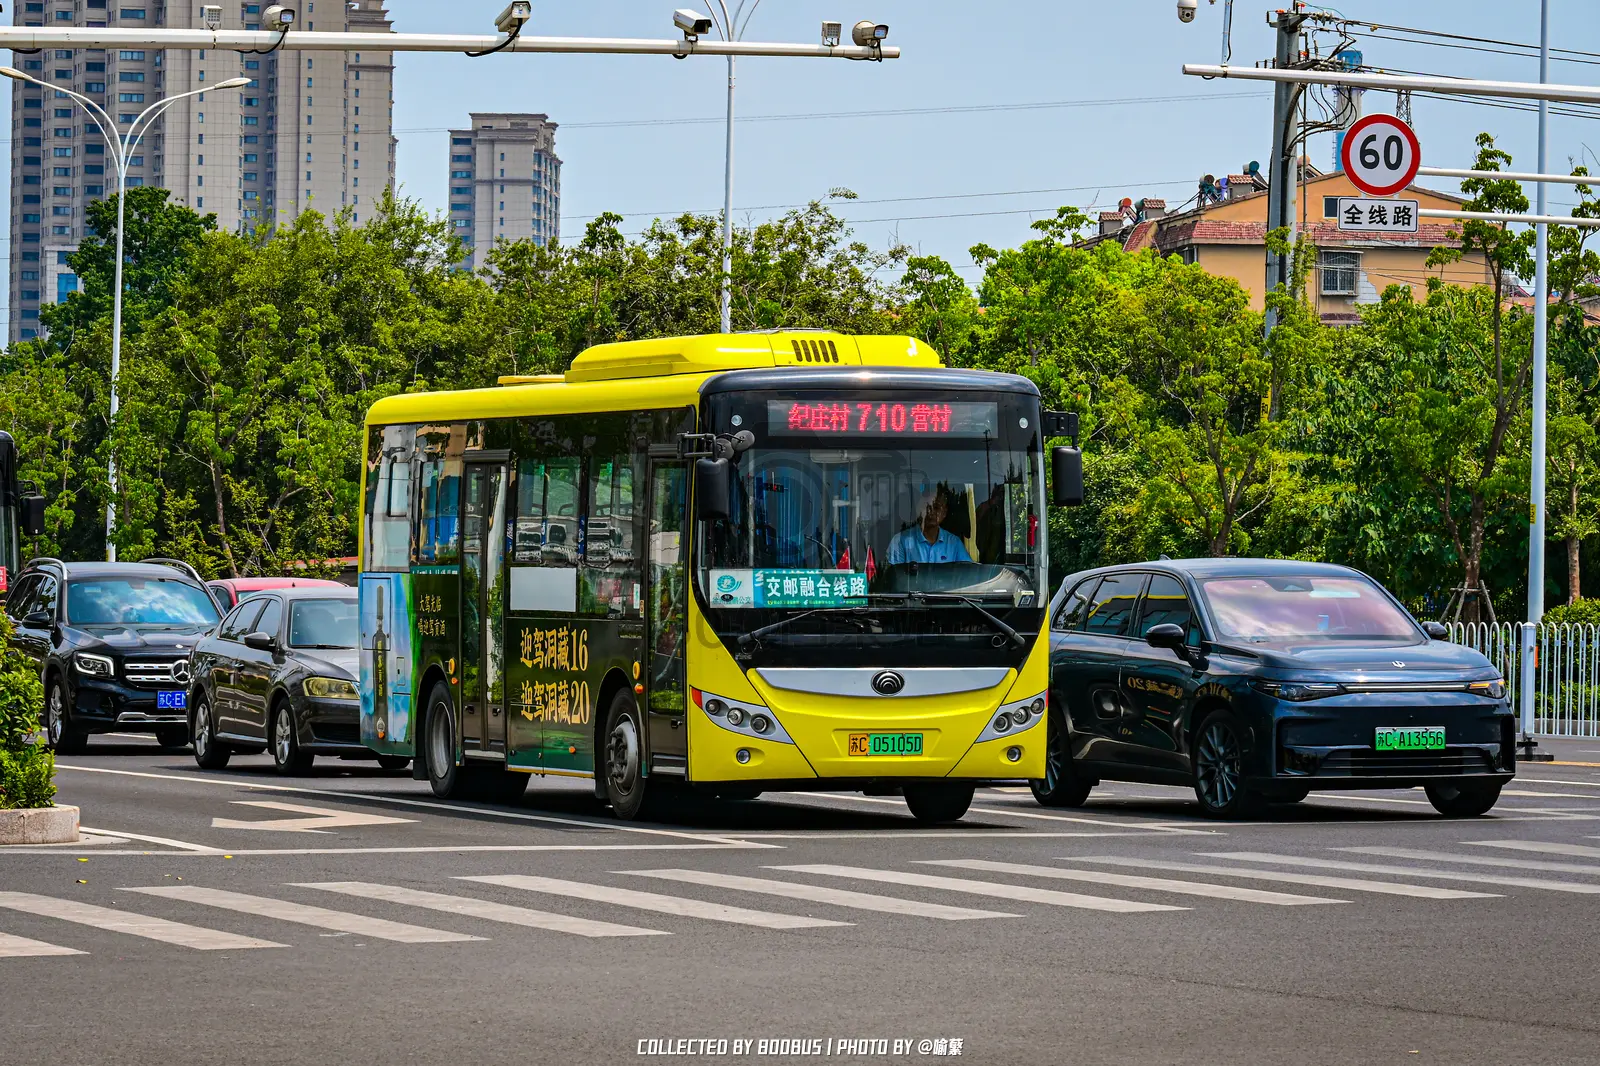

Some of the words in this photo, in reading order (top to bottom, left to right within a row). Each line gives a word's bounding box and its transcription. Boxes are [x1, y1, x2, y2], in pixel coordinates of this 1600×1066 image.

[1360, 134, 1403, 170] 60
[1344, 204, 1412, 226] 全线路
[788, 403, 850, 431] 纪庄村
[857, 403, 906, 431] 710
[911, 404, 952, 431] 营村
[766, 576, 866, 598] 交邮融合线路
[520, 625, 588, 672] 迎驾洞藏16
[520, 680, 590, 725] 迎驾洞藏20
